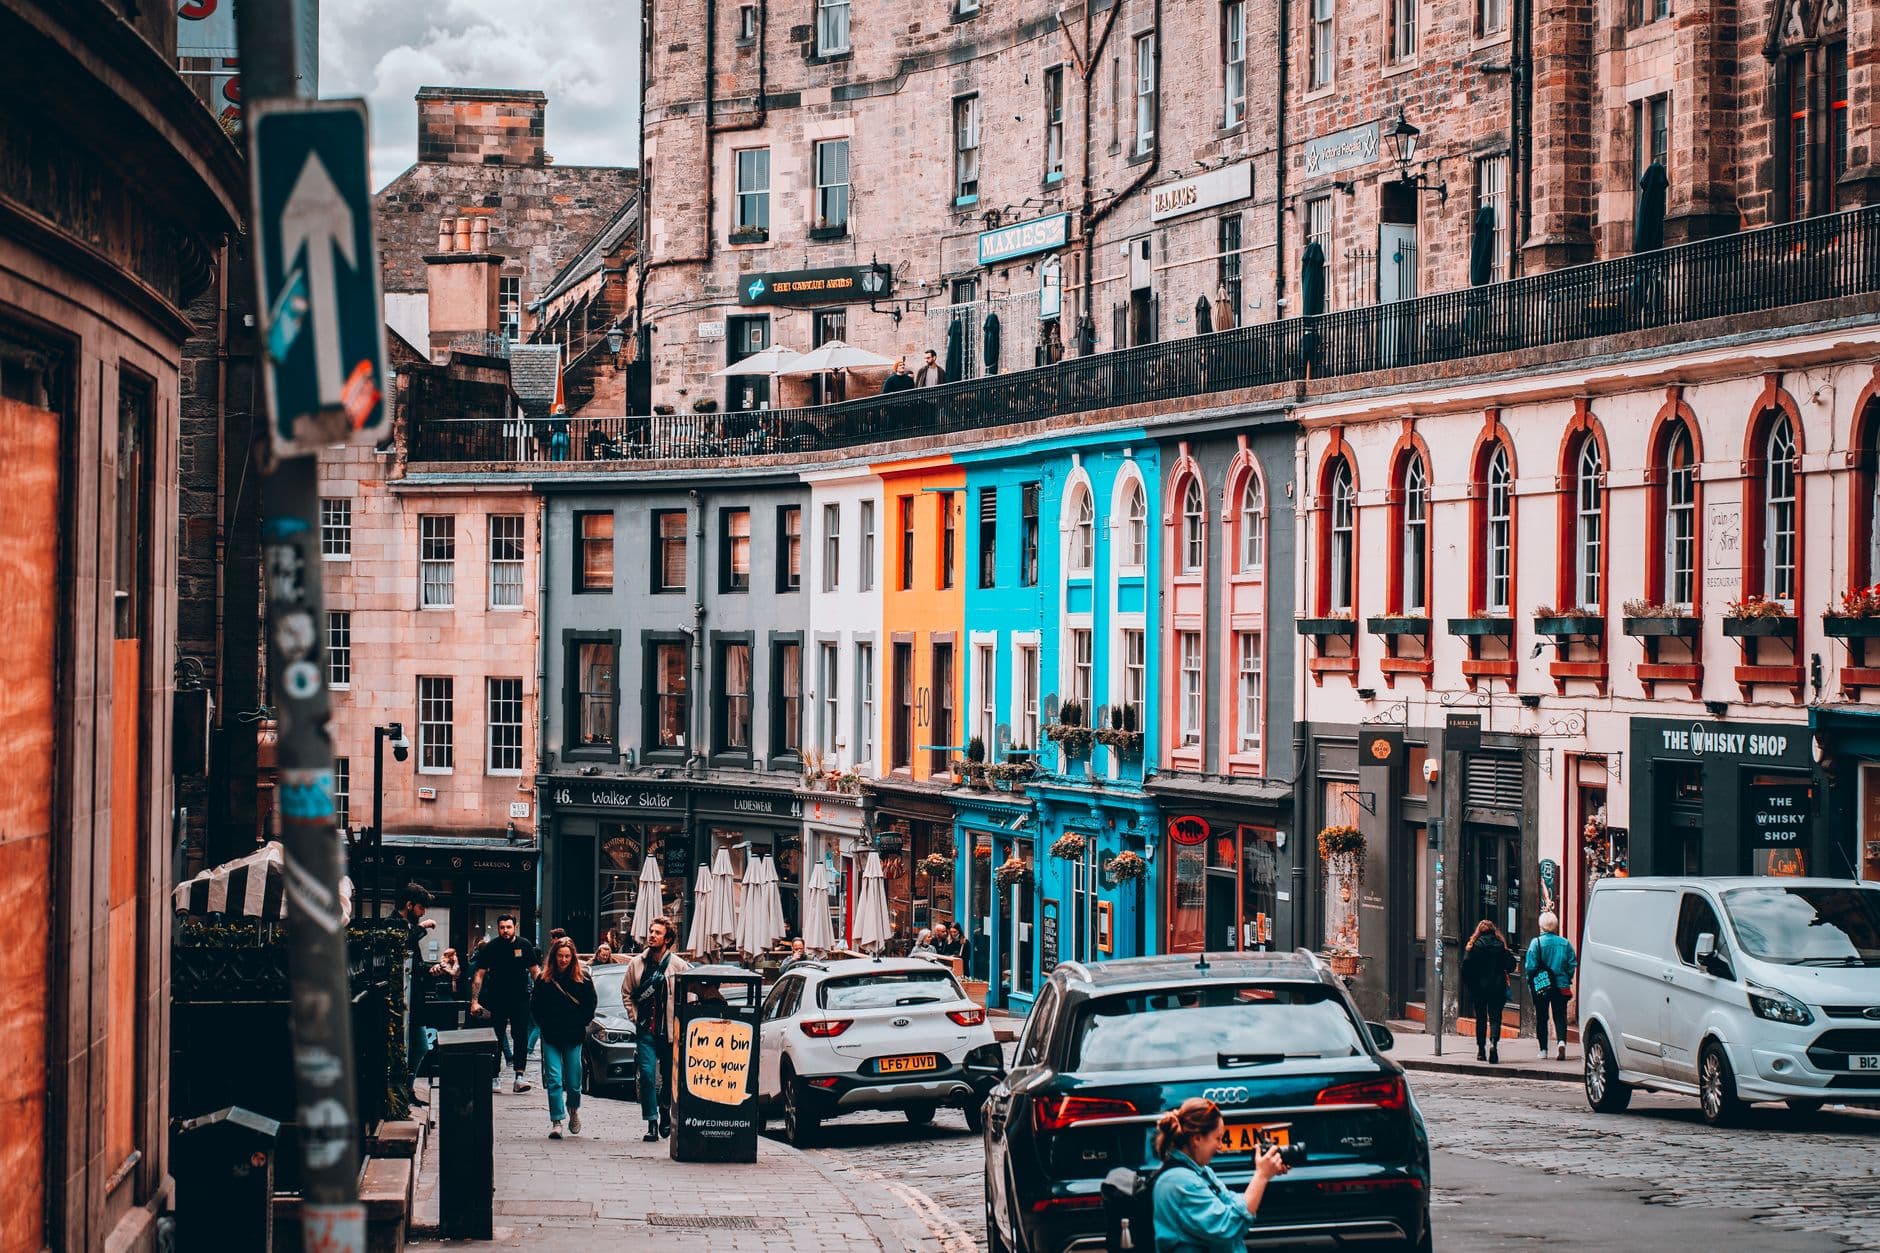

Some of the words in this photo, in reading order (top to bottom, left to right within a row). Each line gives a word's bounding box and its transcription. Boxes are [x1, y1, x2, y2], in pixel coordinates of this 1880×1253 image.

[1662, 730, 1689, 750] THE
[1691, 731, 1745, 754] WHISKY
[1749, 734, 1787, 756] SHOP
[592, 790, 632, 805] Walker
[639, 792, 673, 807] Slater
[734, 799, 772, 813] LADIESWEAR
[1769, 797, 1793, 807] THE
[1756, 811, 1805, 825] WHISKY
[1764, 831, 1797, 841] SHOP
[690, 1027, 709, 1048] I'm
[715, 1036, 724, 1048] a
[731, 1033, 750, 1050] bin
[688, 1055, 717, 1071] Drop
[721, 1061, 746, 1074] your
[880, 1057, 910, 1071] LF67
[912, 1055, 935, 1068] UVD
[1860, 1056, 1878, 1069] B12
[693, 1072, 724, 1088] litter
[727, 1075, 737, 1089] in
